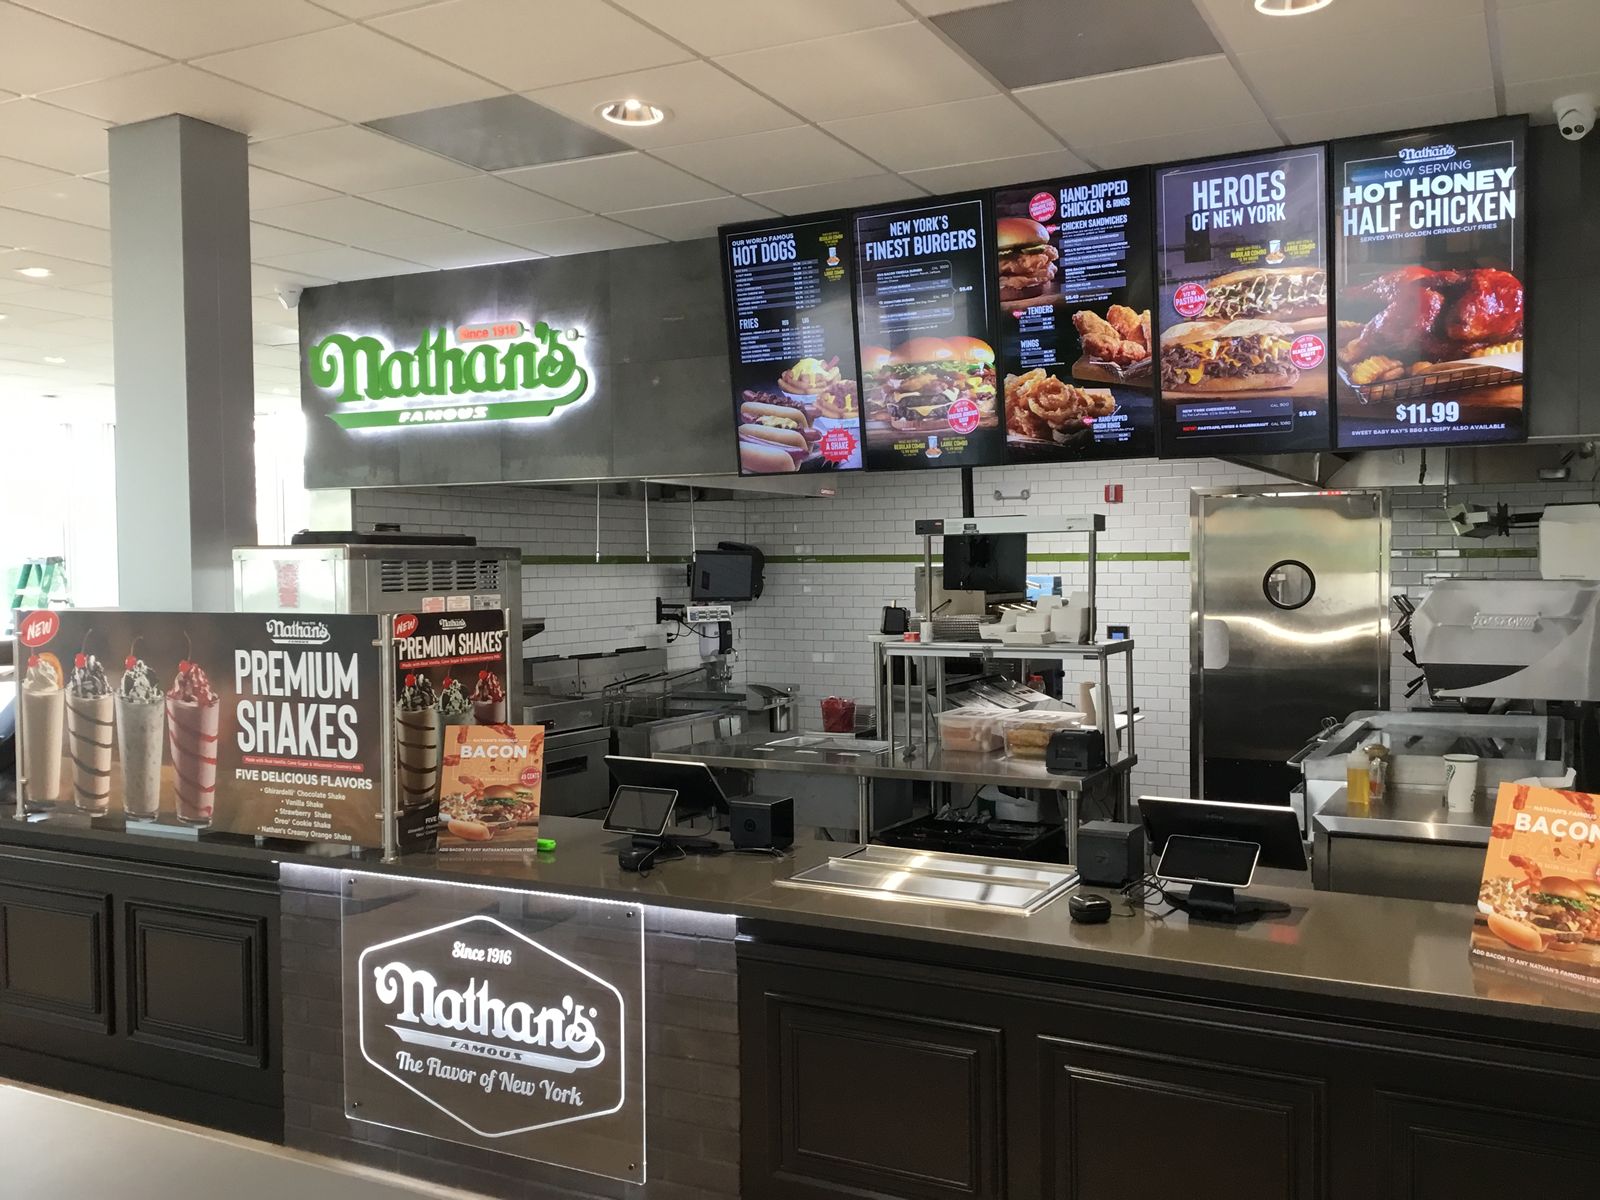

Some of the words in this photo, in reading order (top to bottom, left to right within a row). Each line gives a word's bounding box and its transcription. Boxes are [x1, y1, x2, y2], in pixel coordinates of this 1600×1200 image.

[1398, 144, 1456, 161] Nathan's
[1384, 167, 1414, 178] NOW
[1418, 160, 1472, 174] SERVING
[1060, 180, 1128, 204] HAND-DIPPED
[1192, 170, 1286, 211] HEROES
[1343, 180, 1403, 206] HOT
[1409, 166, 1517, 199] HONEY
[1060, 199, 1104, 219] CHICKEN
[1112, 197, 1131, 208] RINGS
[1192, 212, 1209, 232] OF
[1213, 208, 1244, 229] NEW
[1247, 202, 1286, 224] YORK
[1343, 203, 1403, 237] HALF
[1409, 190, 1516, 230] CHICKEN
[890, 220, 912, 236] NEW
[912, 215, 948, 233] YORK'S
[1061, 220, 1088, 232] CHICKEN
[1088, 215, 1128, 228] SANDWICHES
[1360, 235, 1385, 243] SERVED
[1386, 232, 1404, 240] WITH
[1404, 230, 1432, 238] GOLDEN
[1433, 225, 1477, 236] CRINKLE-CUT
[746, 236, 768, 245] WORLD
[768, 233, 794, 242] FAMOUS
[865, 238, 911, 262] FINEST
[914, 229, 976, 256] BURGERS
[732, 245, 758, 266] HOT
[761, 240, 796, 263] DOGS
[1028, 305, 1054, 314] TENDERS
[1176, 294, 1206, 306] PASTRAMI
[739, 318, 759, 330] FRIES
[1020, 339, 1040, 348] WINGS
[308, 320, 588, 403] Nathan's
[398, 406, 488, 424] FAMOUS
[1396, 401, 1460, 424] $11.99
[826, 442, 830, 450] A
[831, 441, 849, 450] SHAKE
[27, 617, 52, 640] NEW
[266, 619, 329, 638] Nathan's
[396, 618, 416, 632] NEW
[439, 618, 466, 630] Nathan's
[399, 634, 454, 660] PREMIUM
[458, 630, 502, 654] SHAKES
[234, 649, 358, 700] PREMIUM
[236, 700, 358, 760] SHAKES
[460, 745, 528, 758] BACON
[235, 768, 259, 781] FIVE
[262, 772, 318, 786] DELICIOUS
[320, 776, 372, 790] FLAVORS
[286, 799, 305, 808] Vanilla
[306, 800, 324, 808] Shake
[296, 790, 326, 799] Chocolate
[327, 792, 346, 801] Shake
[280, 808, 311, 818] Strawberry
[314, 811, 332, 820] Shake
[1534, 806, 1568, 816] NATHAN'S
[1568, 810, 1597, 820] FAMOUS
[262, 826, 286, 835] Nathan's
[287, 828, 310, 838] Creamy
[310, 830, 332, 840] Orange
[334, 833, 352, 842] Shake
[292, 819, 312, 828] Cookie
[314, 822, 332, 830] Shake
[1514, 812, 1600, 843] BACON
[452, 940, 486, 962] Since
[487, 947, 512, 966] 1916
[1472, 948, 1484, 956] ADD
[1486, 952, 1506, 961] BACON
[1530, 962, 1560, 974] NATHAN'S
[1560, 970, 1586, 982] FAMOUS
[374, 961, 605, 1054] Nathan's
[450, 1040, 522, 1062] FAMOUS
[396, 1050, 424, 1073] The
[426, 1056, 477, 1084] Flavor
[480, 1068, 496, 1094] of
[498, 1070, 536, 1097] New
[539, 1079, 584, 1107] York
